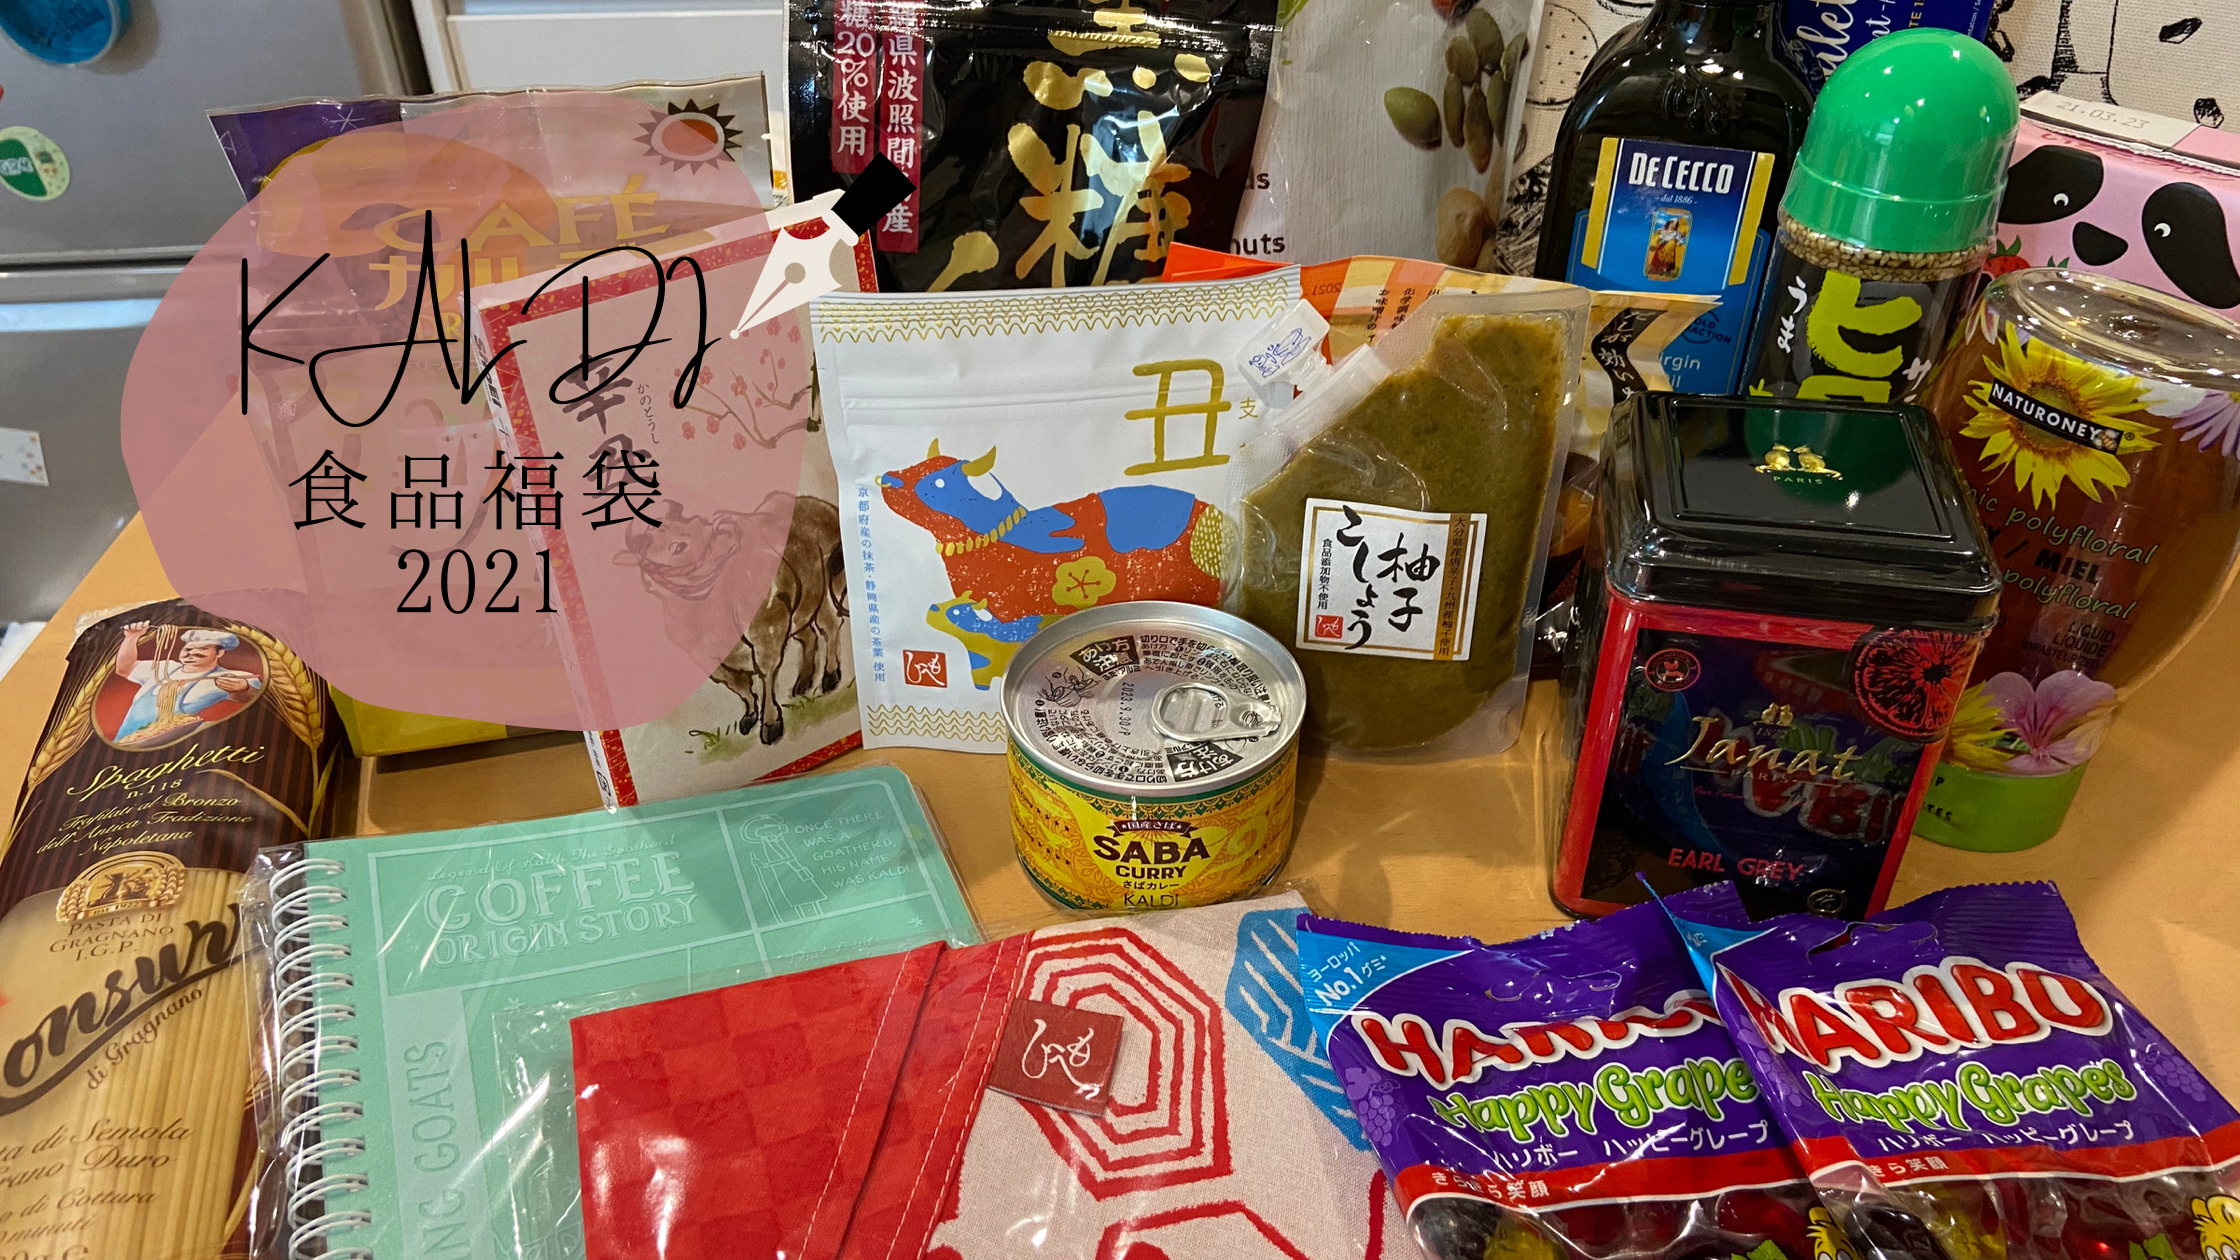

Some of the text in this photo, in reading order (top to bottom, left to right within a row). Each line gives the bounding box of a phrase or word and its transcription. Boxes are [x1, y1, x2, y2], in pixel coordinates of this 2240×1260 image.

[2055, 100, 2150, 130] 21.03.23
[1628, 152, 1734, 195] DE CECCO
[372, 173, 672, 253] CAFÉ
[1991, 382, 2103, 443] NATURONEY
[1773, 475, 1823, 485] PARIS
[1376, 532, 1441, 632] 柚子
[2034, 547, 2101, 585] MIEL
[66, 743, 265, 802] Spaghetti
[58, 803, 136, 834] Trafilati
[162, 791, 242, 808] Bronzo
[74, 817, 142, 844] Antica
[146, 810, 254, 827] Tradizione
[794, 810, 884, 834] ONCE THERE
[78, 828, 197, 857] Napoletana
[802, 832, 851, 848] WAS A
[1092, 835, 1211, 865] SABA
[821, 853, 891, 876] HIS NAME
[1115, 865, 1188, 880] CURRY
[1668, 848, 1805, 882] EARL GREY
[830, 875, 864, 889] WAS
[1122, 880, 1180, 891] さばカレー
[1123, 893, 1179, 908] KALDI
[68, 912, 163, 937] PASTA DI
[574, 893, 699, 944] STORY
[49, 926, 175, 954] GRAGNANO
[75, 941, 139, 962] I.G.P.
[1307, 940, 1361, 983] ヨーロッパ
[1717, 956, 2113, 1073] HARIBO
[87, 987, 204, 1090] di Gragnano
[403, 1041, 462, 1173] GOATS
[1426, 1078, 1598, 1145] Happy
[1802, 1057, 2137, 1132] Happy Grapes
[31, 1124, 68, 1154] di
[70, 1117, 196, 1143] Semola
[80, 1144, 178, 1172] Duro
[57, 1187, 158, 1210] Cottura
